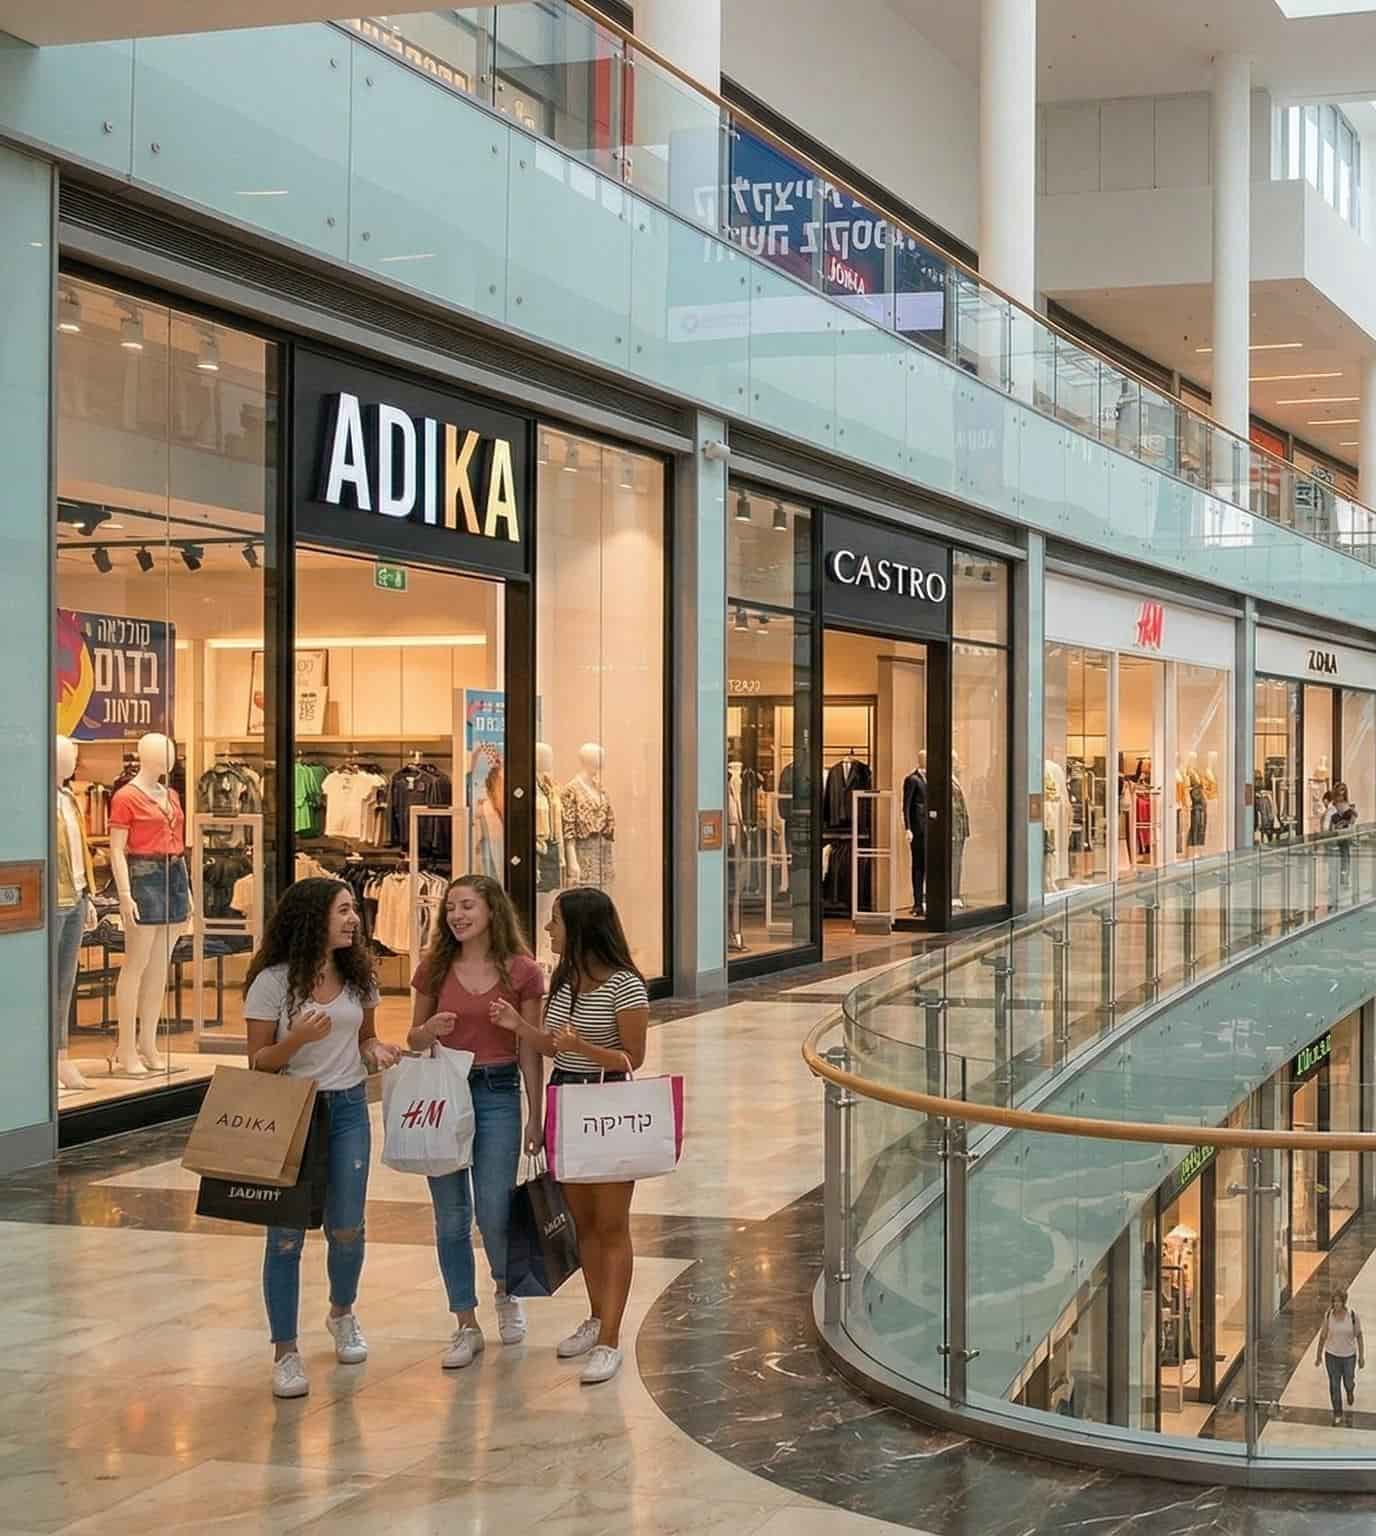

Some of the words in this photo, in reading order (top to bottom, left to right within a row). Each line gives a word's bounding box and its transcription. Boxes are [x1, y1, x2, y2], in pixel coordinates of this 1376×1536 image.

[325, 391, 521, 543] ADIKA
[833, 549, 947, 603] CASTRO
[216, 1112, 276, 1133] ADIKA
